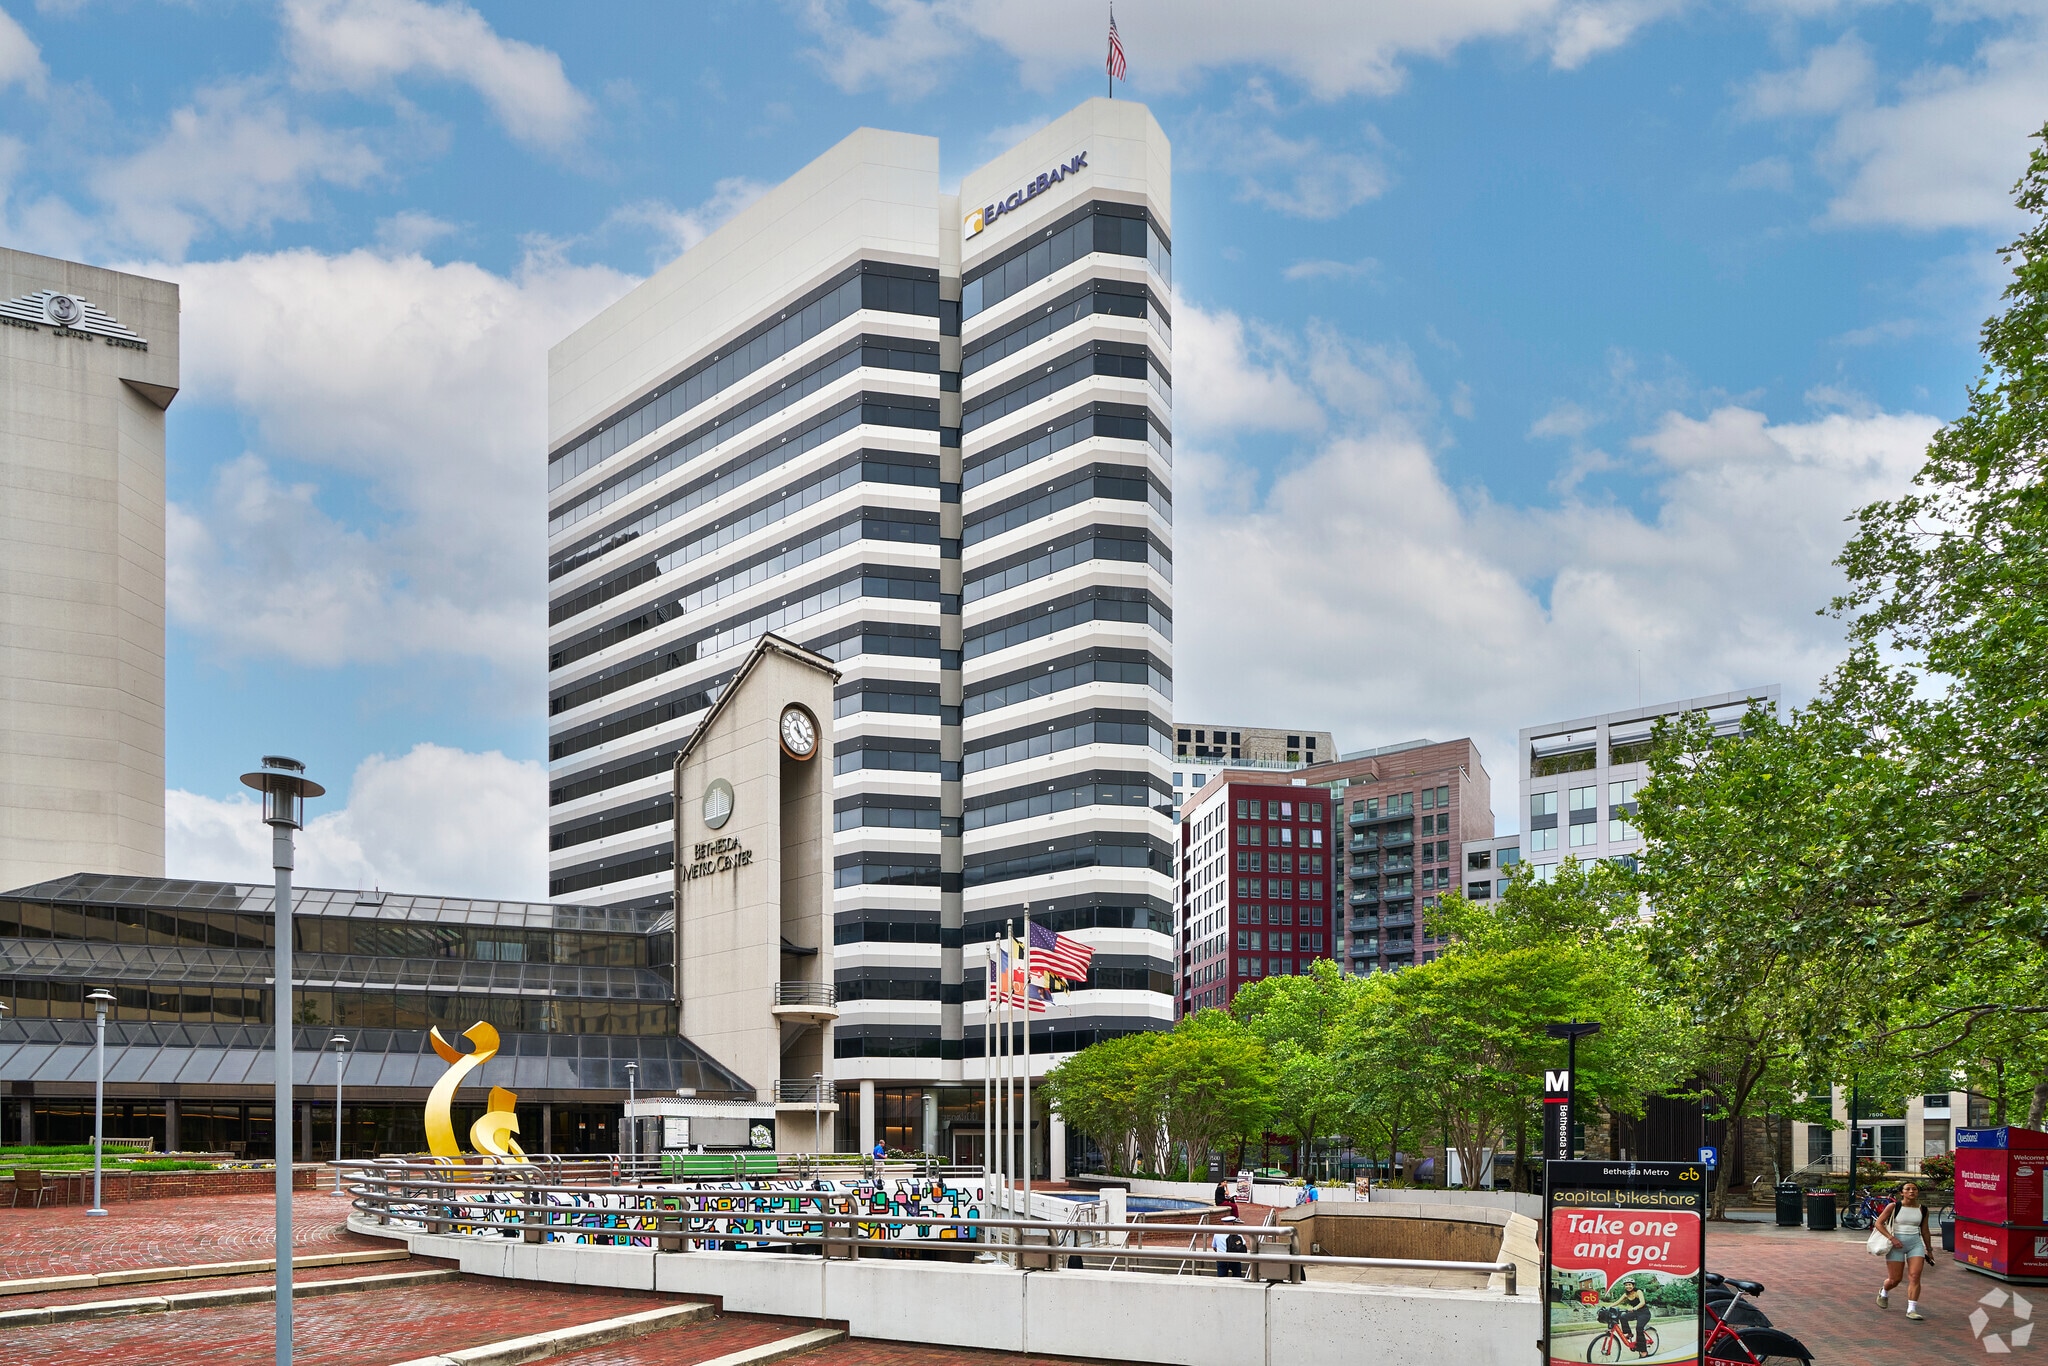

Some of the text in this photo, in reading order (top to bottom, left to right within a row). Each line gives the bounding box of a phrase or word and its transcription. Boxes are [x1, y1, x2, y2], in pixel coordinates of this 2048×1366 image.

[984, 151, 1088, 226] EAGLEBANK
[54, 298, 72, 319] 3
[695, 836, 742, 861] BETHESDA
[683, 850, 753, 882] METRO CENTER
[1545, 1071, 1569, 1092] M
[1560, 1104, 1568, 1148] Bethesda
[1957, 1132, 1978, 1143] Questions?
[1701, 1150, 1713, 1162] P
[1603, 1168, 1641, 1176] Bethesda
[1554, 1190, 1695, 1205] capital bikeshare
[1568, 1214, 1678, 1237] Take one
[1573, 1239, 1670, 1265] and go!
